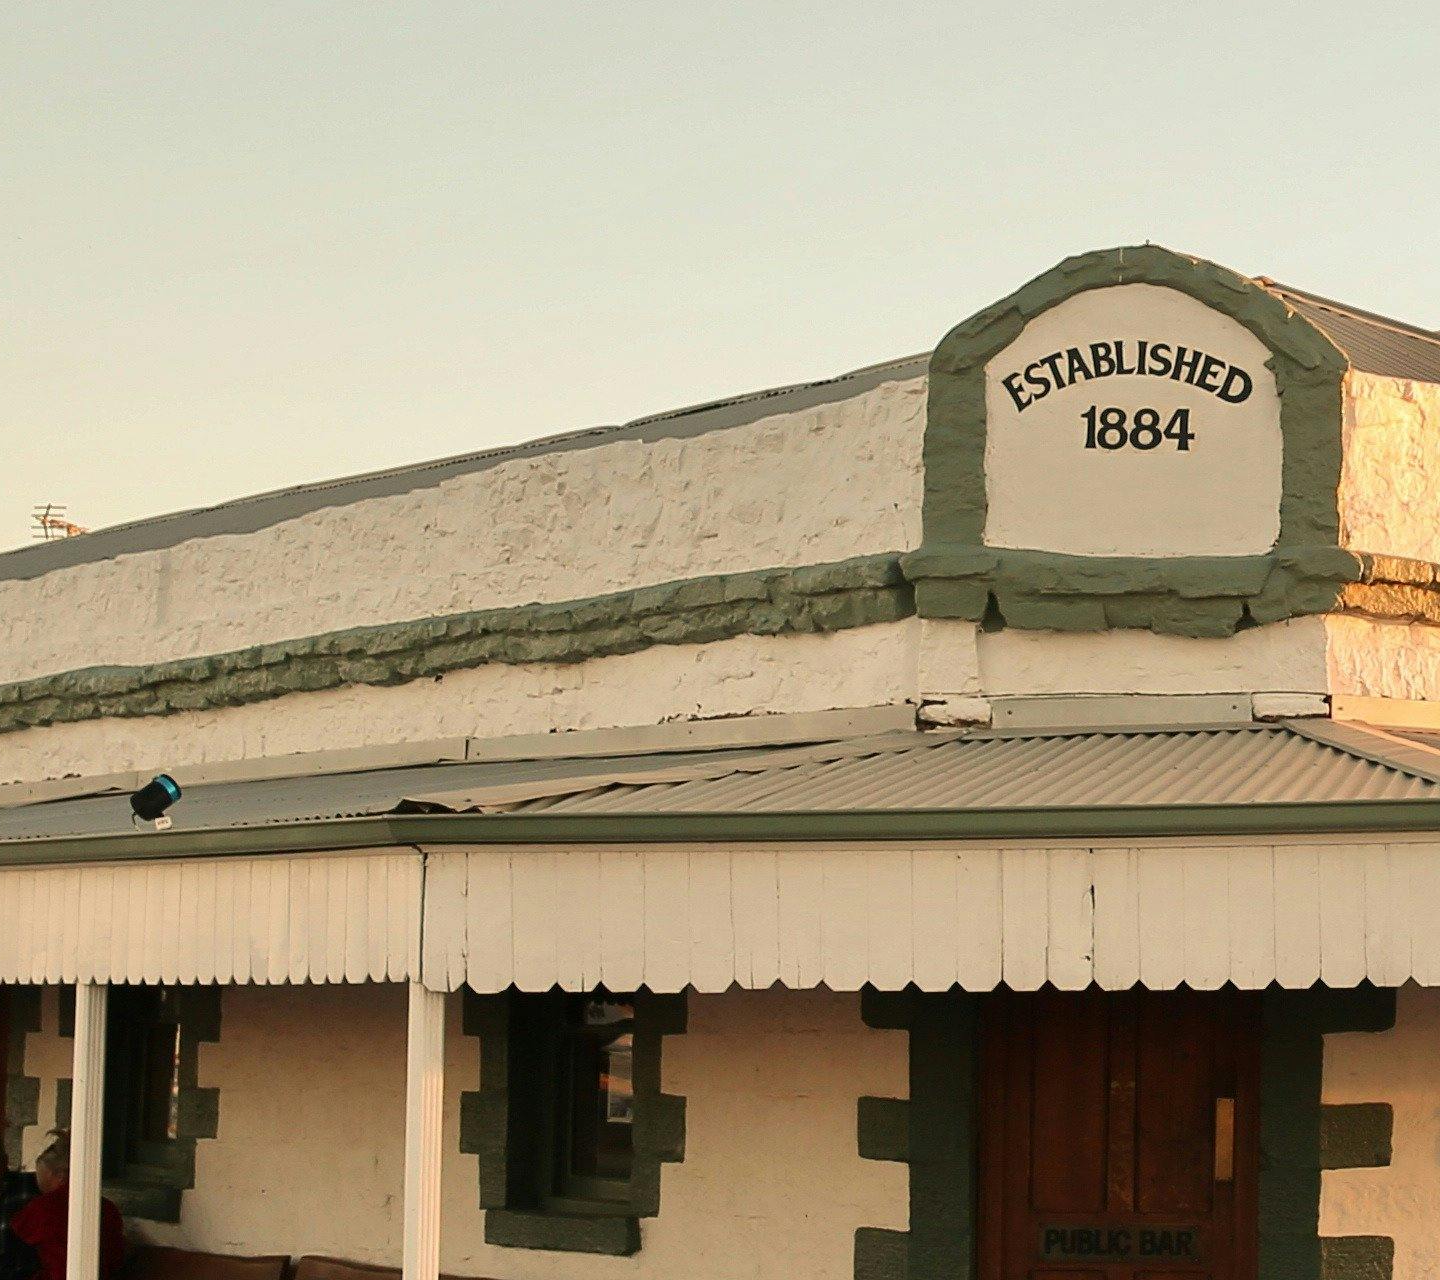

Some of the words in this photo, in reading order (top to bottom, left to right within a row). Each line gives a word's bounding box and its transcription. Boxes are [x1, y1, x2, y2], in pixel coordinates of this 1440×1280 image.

[1002, 340, 1254, 412] ESTABLISHED
[1081, 405, 1195, 451] 1884
[1044, 1228, 1133, 1256] PUBLIC
[1138, 1228, 1195, 1256] BAR
